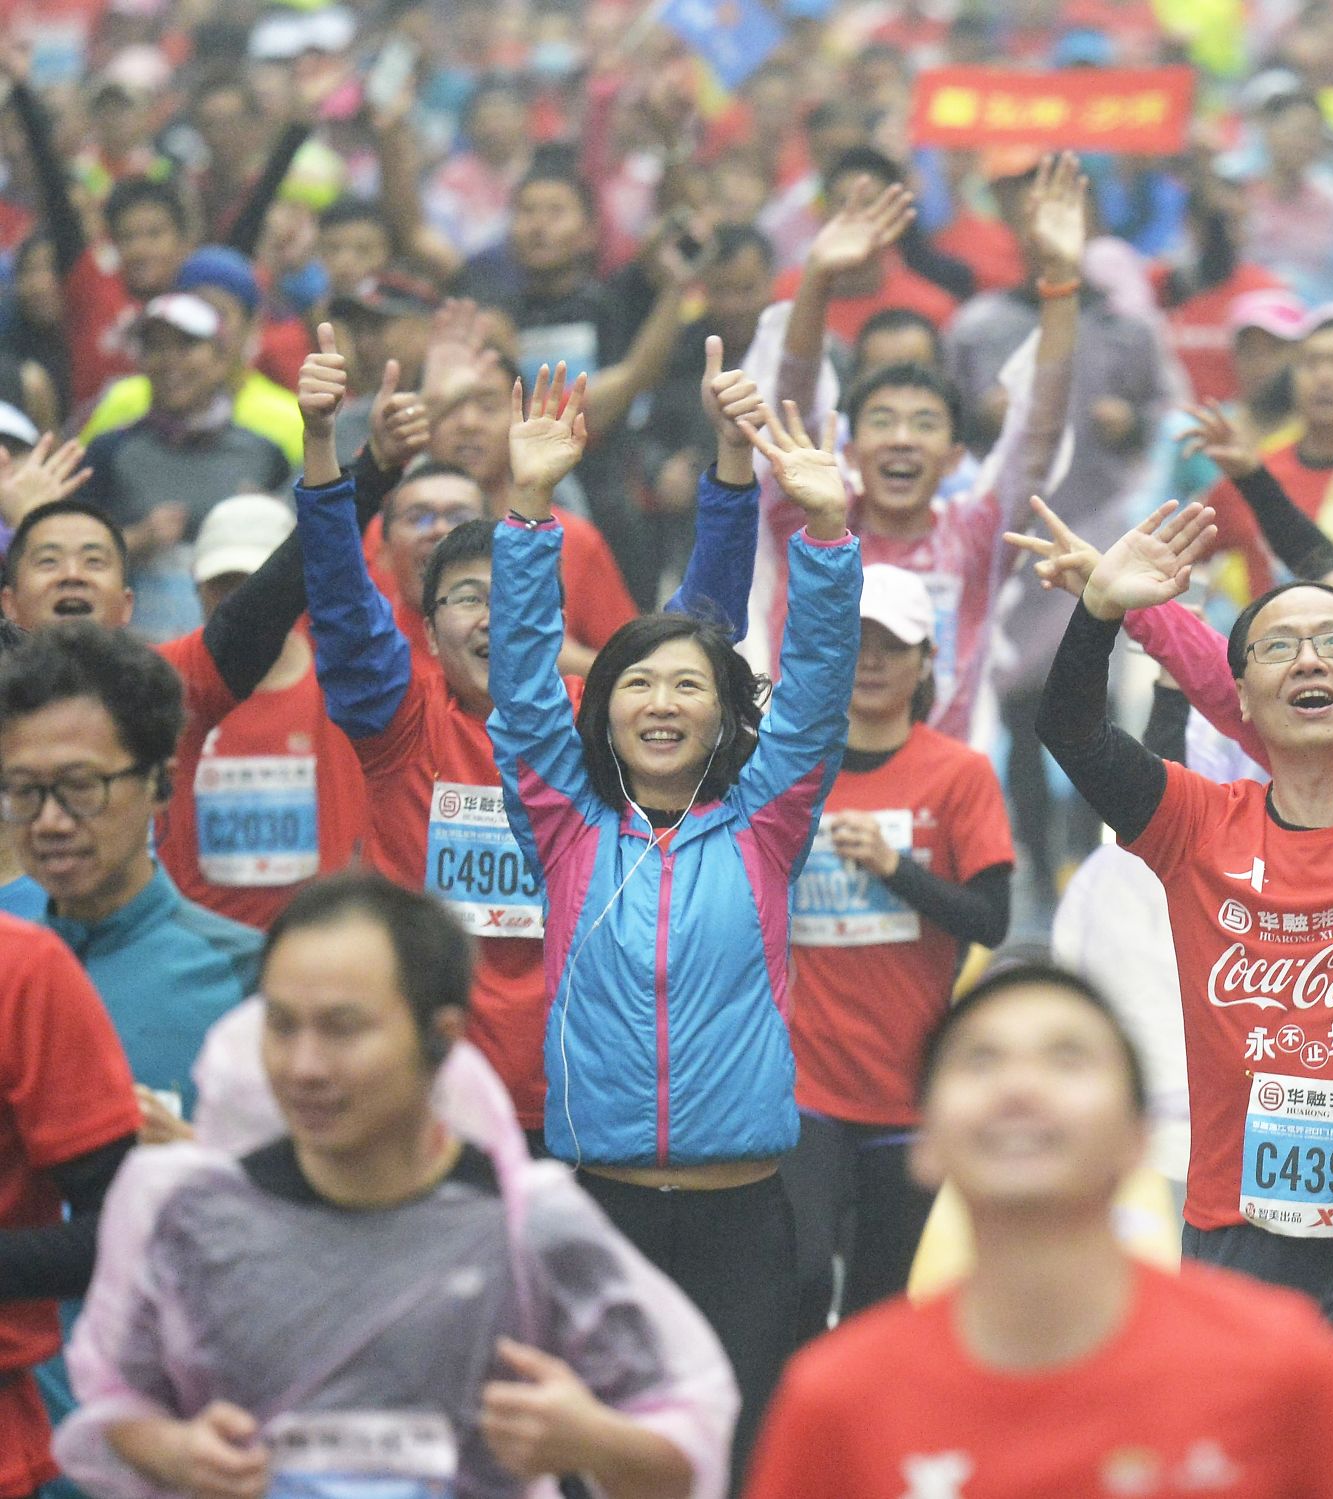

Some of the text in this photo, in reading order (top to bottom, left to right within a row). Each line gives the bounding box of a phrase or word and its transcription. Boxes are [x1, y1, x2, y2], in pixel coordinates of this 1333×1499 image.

[437, 848, 540, 898] C4905
[1259, 931, 1315, 943] HUARONG
[1286, 1107, 1330, 1118] HUARONG
[1258, 1208, 1302, 1224] 智美出品
